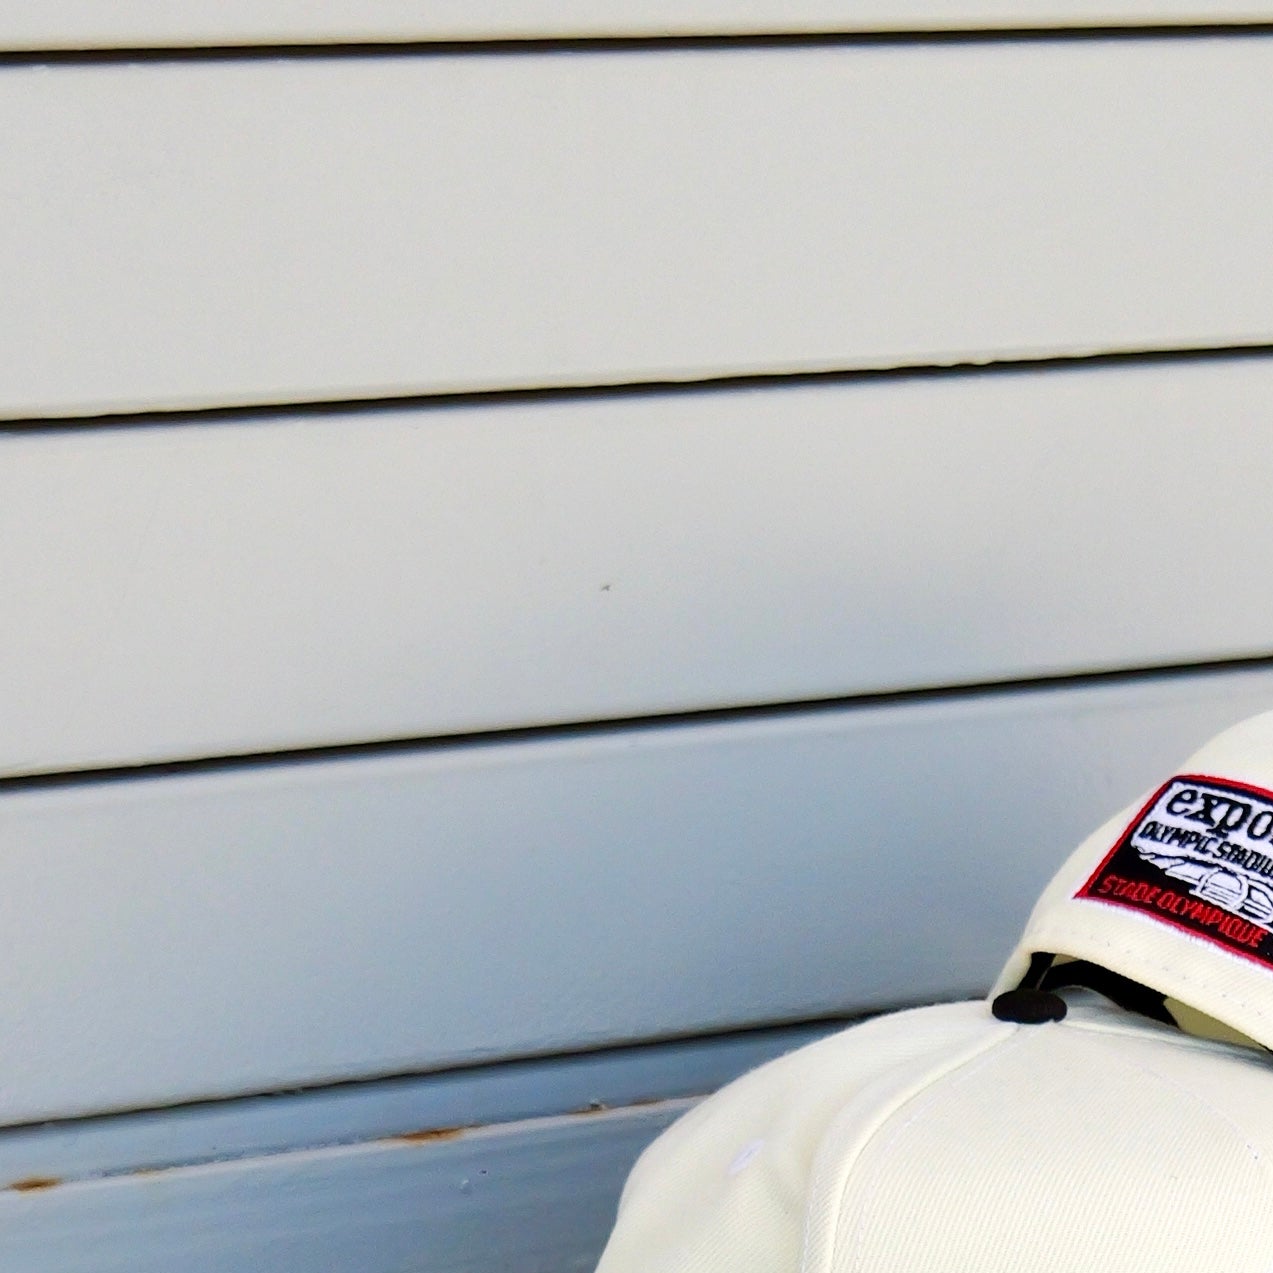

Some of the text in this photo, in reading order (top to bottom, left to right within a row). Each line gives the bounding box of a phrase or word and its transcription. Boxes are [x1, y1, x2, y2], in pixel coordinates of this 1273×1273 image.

[1138, 820, 1219, 855] OLYMPIC
[1098, 875, 1269, 948] STADE OLYMPIQUE
